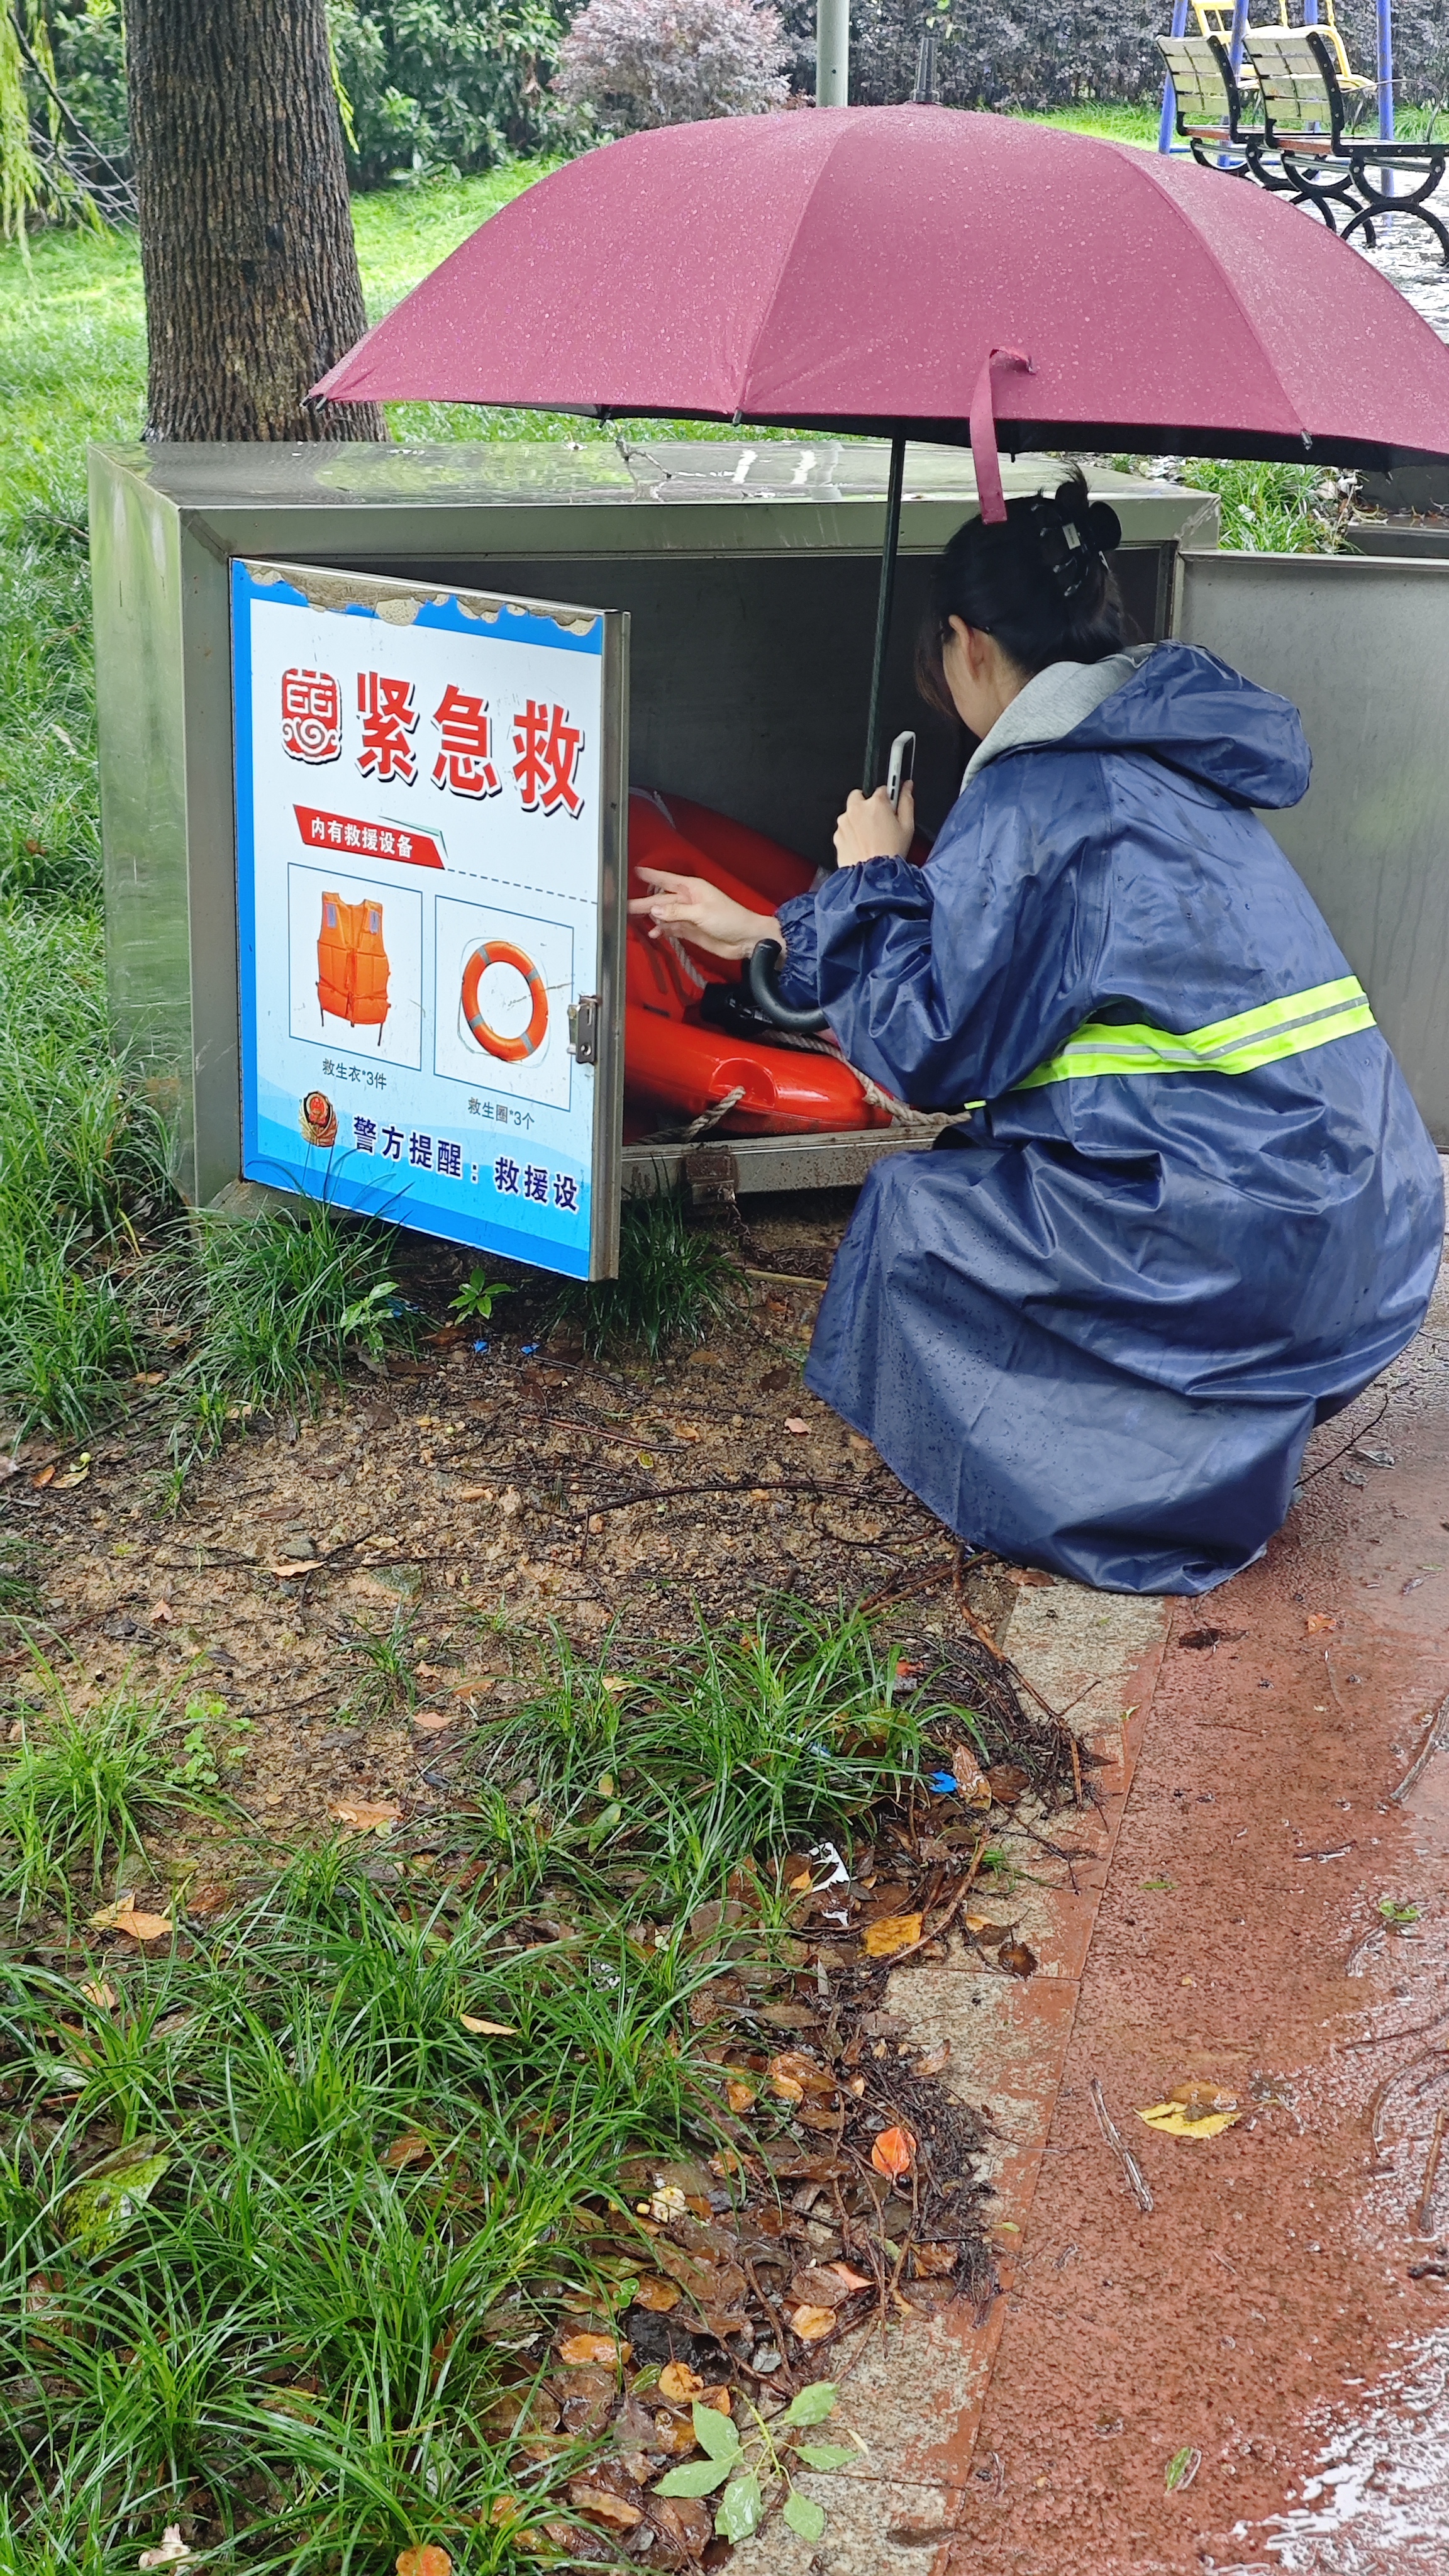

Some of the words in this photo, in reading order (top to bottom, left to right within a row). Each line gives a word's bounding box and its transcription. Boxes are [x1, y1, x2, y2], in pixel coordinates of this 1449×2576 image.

[356, 670, 584, 818] 紧急救
[311, 816, 413, 858] 内有救援设备
